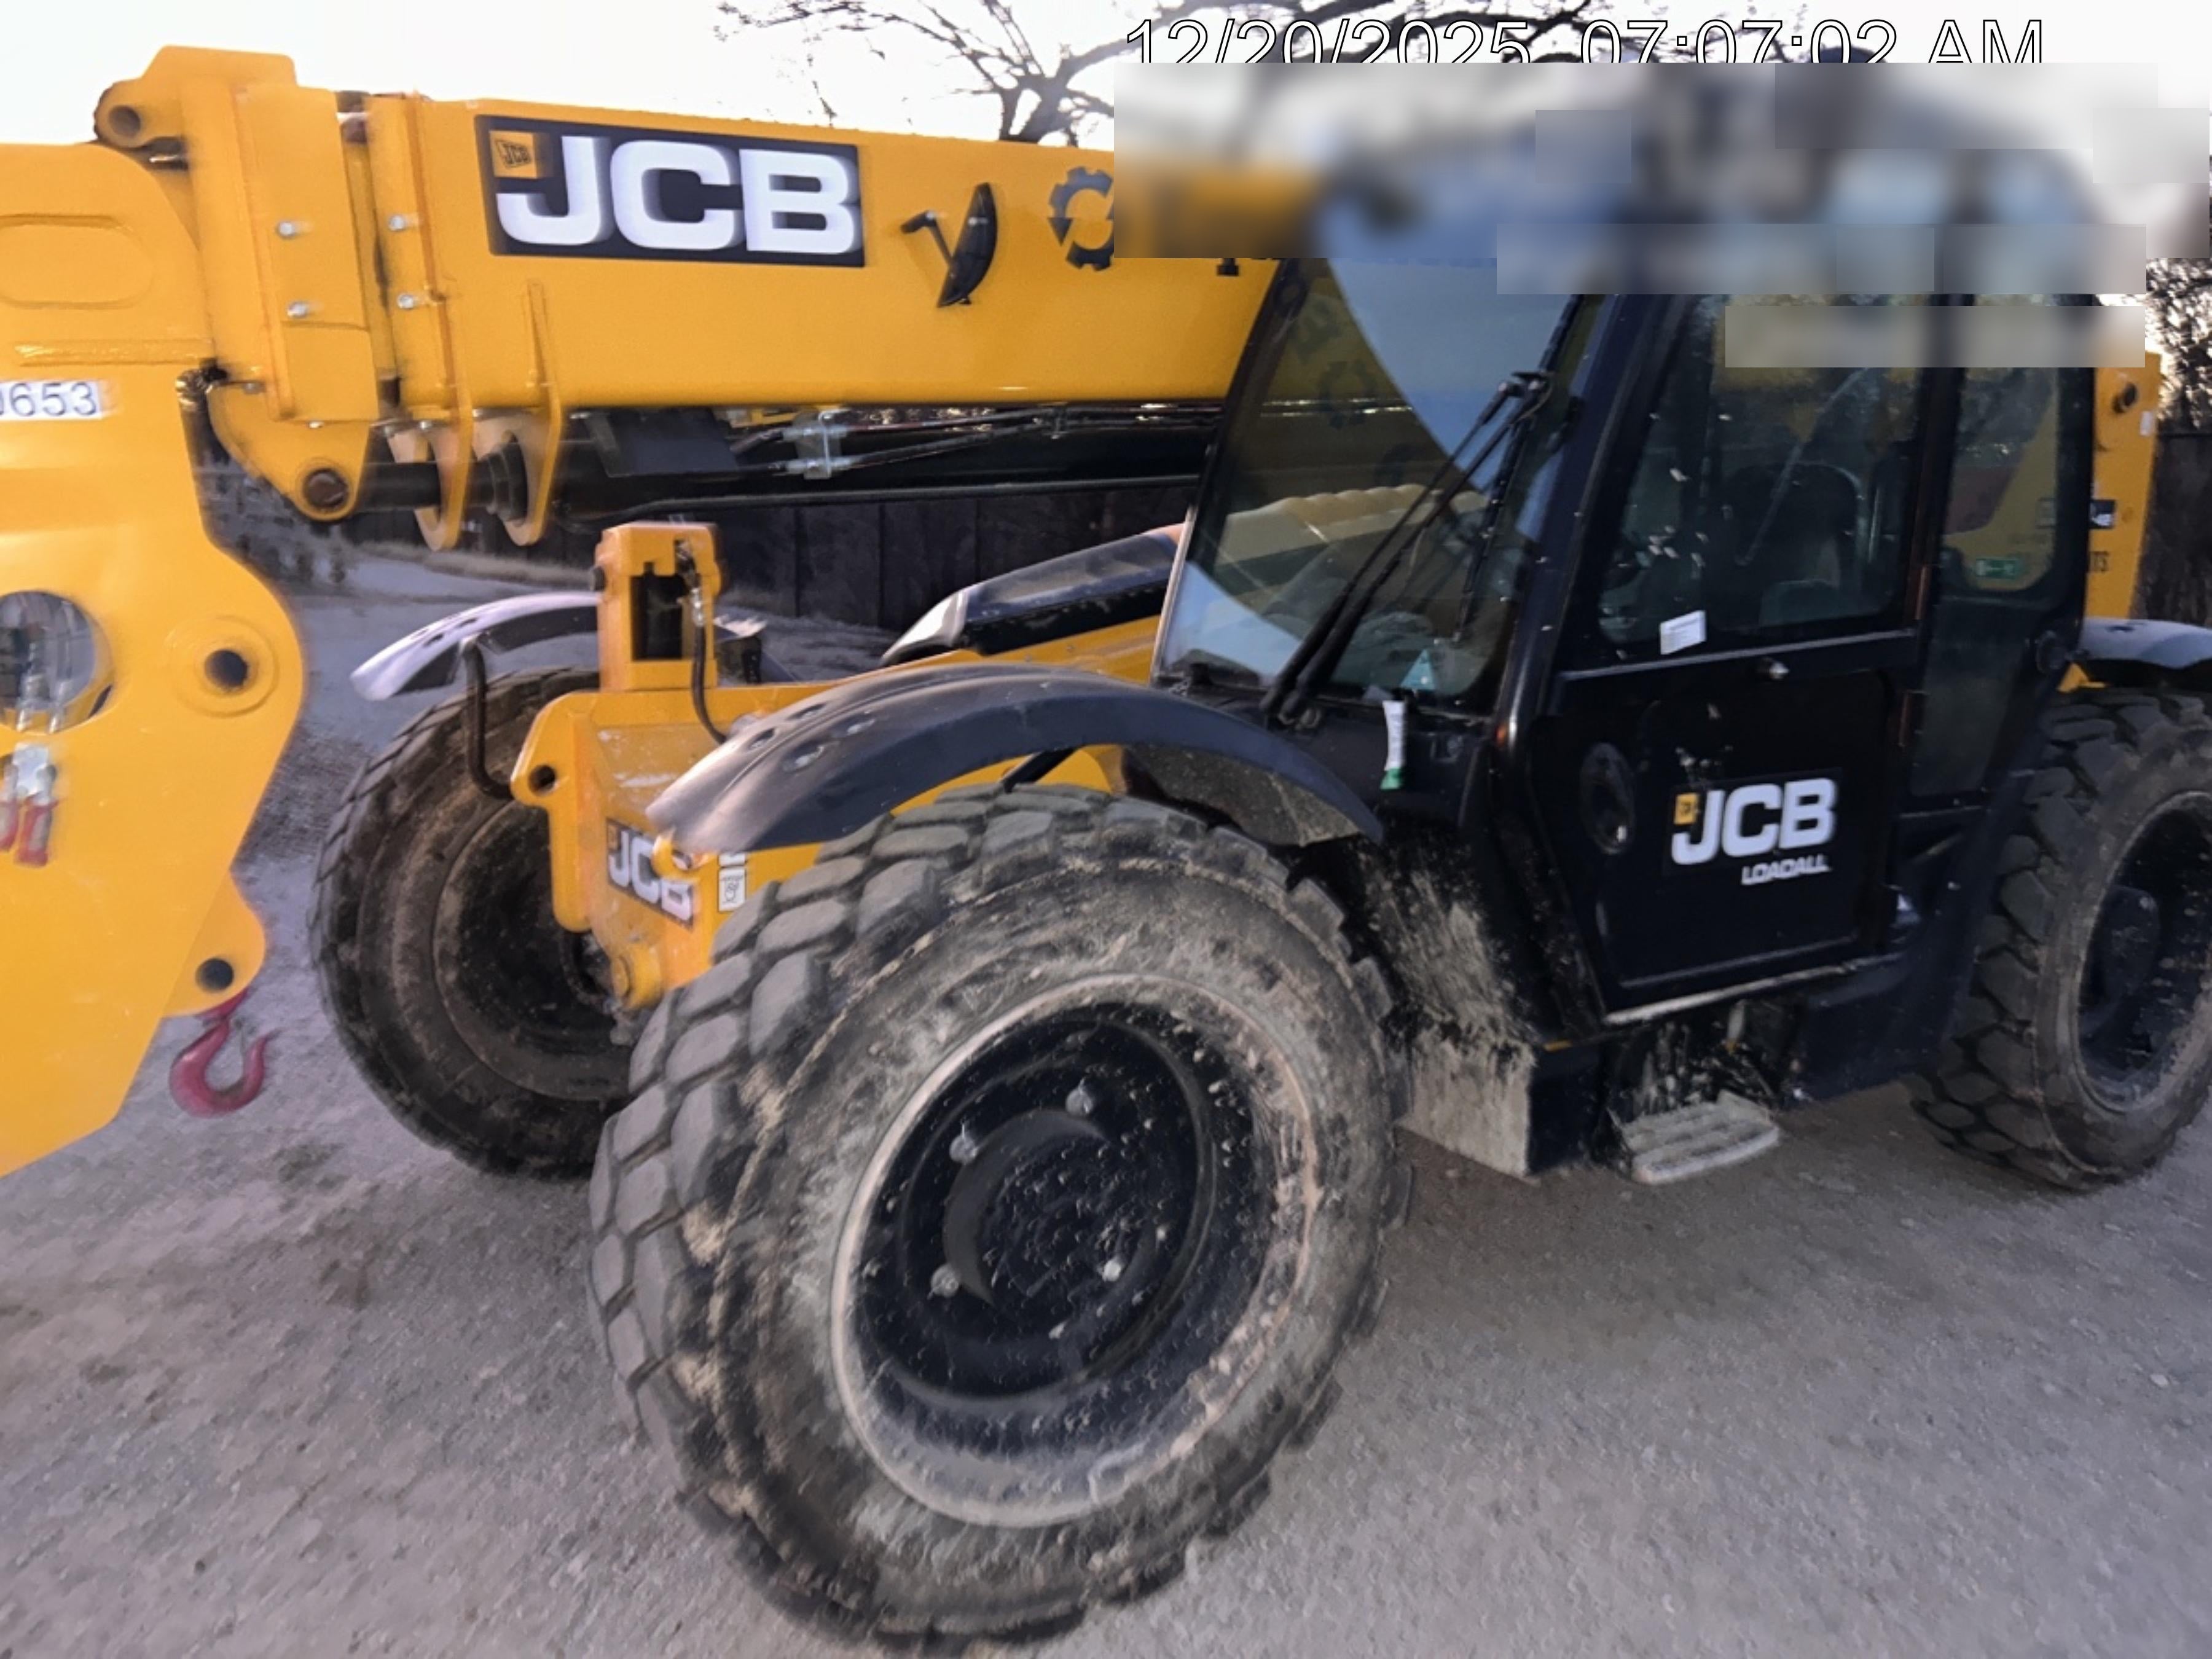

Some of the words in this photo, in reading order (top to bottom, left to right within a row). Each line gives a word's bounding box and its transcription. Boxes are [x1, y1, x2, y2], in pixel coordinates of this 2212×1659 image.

[496, 135, 859, 254] JCB
[0, 382, 96, 417] 653
[1671, 778, 1835, 865] JCB
[1741, 854, 1831, 885] LOADALL
